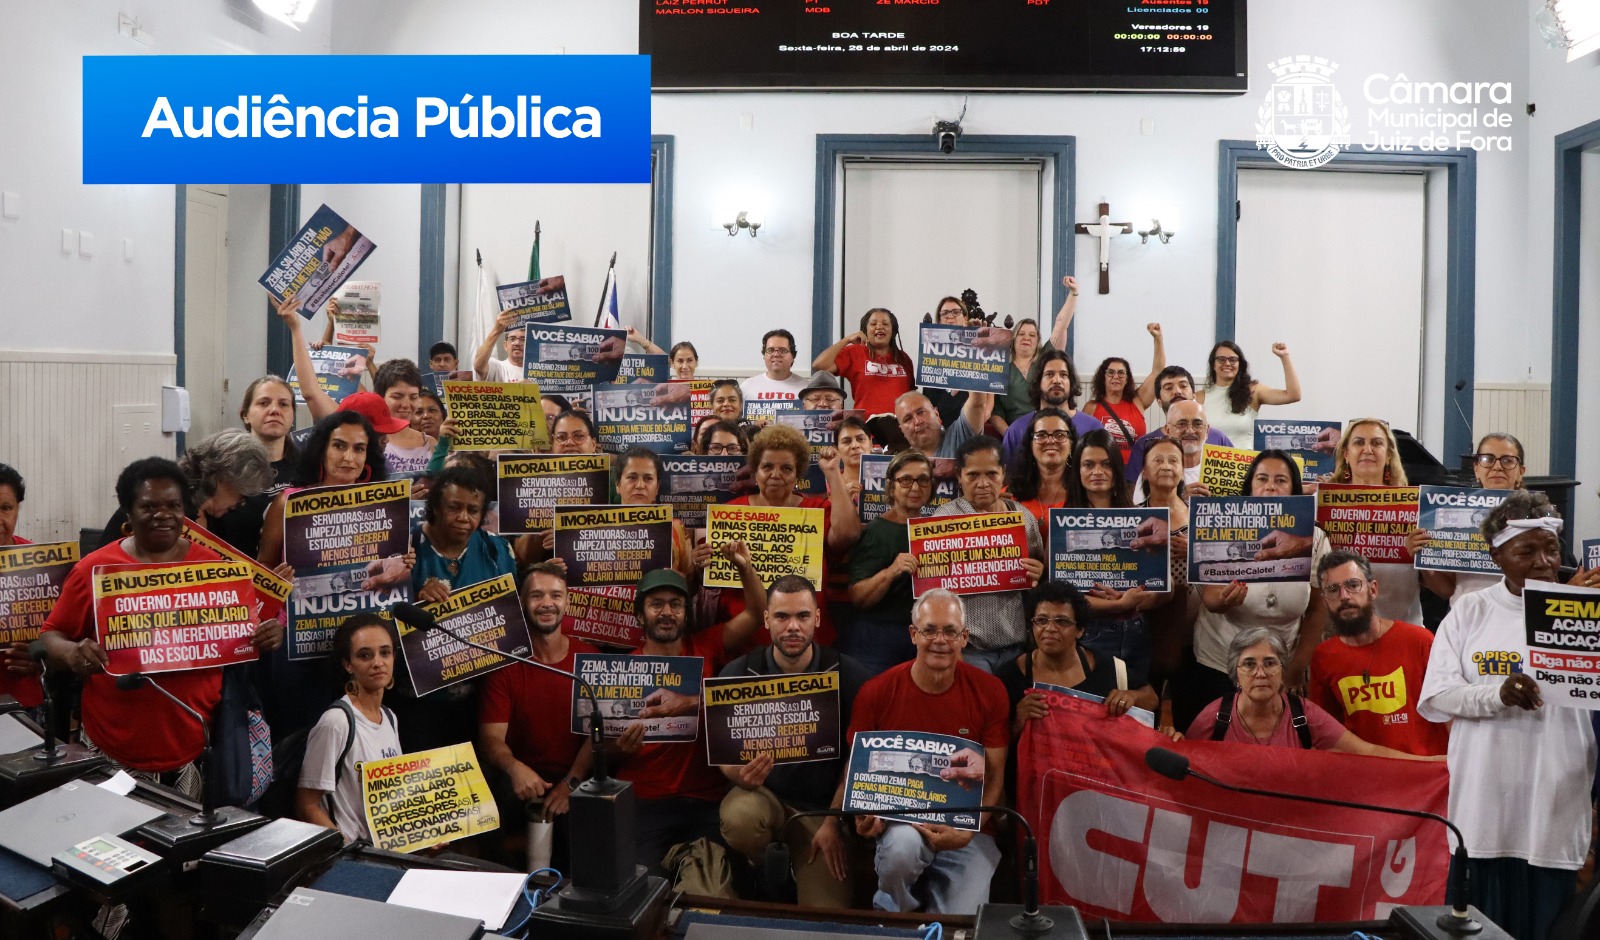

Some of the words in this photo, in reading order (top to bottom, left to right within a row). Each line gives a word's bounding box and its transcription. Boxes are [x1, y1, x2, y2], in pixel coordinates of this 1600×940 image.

[265, 267, 287, 289] ZEMA,
[280, 238, 308, 272] SALÁRIO
[299, 227, 318, 245] TEM
[310, 262, 352, 310] #BastadeCalote!
[501, 291, 565, 311] INJUSTIÇA!
[532, 330, 564, 342] VOCÊ
[566, 332, 605, 344] SABIA?
[922, 342, 1006, 364] INJUSTIÇA!
[447, 384, 473, 394] VOCÊ
[474, 386, 503, 394] SABIA?
[758, 392, 795, 400] LUTO
[448, 394, 478, 402] MINAS
[480, 394, 512, 402] GERAIS
[512, 396, 536, 404] PAGA
[596, 407, 688, 425] INJUSTIÇA!
[1258, 422, 1286, 434] VOCÊ
[1287, 426, 1322, 435] SABIA?
[1206, 449, 1232, 460] VOCÊ
[504, 462, 556, 475] IMORAL!
[558, 458, 604, 472] ILEGAL!
[662, 459, 698, 473] VOCÊ
[699, 462, 741, 473] SABIA?
[292, 494, 353, 514] IMORAL!
[355, 484, 405, 504] ILEGAL!
[1323, 492, 1329, 503] É
[1332, 494, 1382, 503] INJUSTO!
[1384, 490, 1390, 503] É
[1426, 492, 1466, 506] VOCÊ
[712, 509, 742, 521] VOCÊ
[744, 513, 780, 523] SABIA?
[1196, 503, 1224, 517] ZEMA,
[1224, 500, 1262, 516] SALÁRIO
[1263, 504, 1282, 516] TEM
[560, 514, 616, 527] IMORAL!
[618, 509, 667, 522] ILEGAL!
[914, 526, 922, 537] É
[923, 521, 972, 535] INJUSTO!
[974, 518, 981, 529] É
[982, 515, 1022, 528] ILEGAL!
[1056, 513, 1094, 528] VOCÊ
[1096, 516, 1142, 528] SABIA?
[1196, 516, 1213, 528] QUE
[1214, 516, 1231, 528] SER
[1232, 516, 1269, 530] INTEIRO,
[1270, 516, 1276, 528] E
[1277, 514, 1296, 528] NÃO
[923, 538, 964, 552] GOVERNO
[965, 536, 990, 548] ZEMA
[990, 534, 1014, 546] PAGA
[1196, 529, 1219, 540] PELA
[1220, 529, 1258, 541] METADE!
[919, 552, 950, 565] MENOS
[950, 550, 967, 563] QUE
[968, 549, 983, 560] UM
[984, 545, 1021, 559] SALÁRIO
[917, 563, 950, 579] MÍNIMO
[951, 562, 962, 575] ÀS
[963, 558, 1025, 574] MERENDEIRAS
[1204, 566, 1276, 577] #BastadeCalote!
[102, 578, 112, 593] É
[115, 573, 182, 591] INJUSTO!
[185, 568, 194, 582] É
[196, 566, 249, 581] ILEGAL!
[941, 577, 958, 590] DAS
[960, 574, 1001, 589] ESCOLAS.
[115, 594, 172, 614] GOVERNO
[174, 592, 207, 608] ZEMA
[209, 590, 239, 606] PAGA
[294, 586, 408, 616] INJUSTIÇA!
[108, 614, 150, 632] MENOS
[153, 612, 176, 628] QUE
[178, 610, 198, 626] UM
[200, 604, 249, 624] SALÁRIO
[105, 630, 151, 651] MÍNIMO
[154, 628, 170, 646] ÀS
[140, 647, 164, 665] DAS
[167, 643, 221, 663] ESCOLAS.
[1472, 652, 1484, 663] O
[1485, 651, 1521, 663] PISO
[1532, 652, 1564, 668] Diga
[1566, 657, 1593, 670] não
[581, 660, 609, 674] ZEMA,
[610, 659, 649, 673] SALÁRIO
[650, 662, 670, 674] TEM
[1478, 659, 1487, 676] É
[1488, 662, 1511, 676] LEI
[600, 674, 617, 687] SER
[618, 674, 655, 688] INTEIRO,
[655, 674, 662, 686] E
[663, 672, 682, 687] NÃO
[1536, 670, 1566, 685] Diga
[1568, 675, 1593, 686] não
[605, 686, 643, 699] METADE!
[712, 683, 775, 703] IMORAL!
[777, 677, 832, 695] ILEGAL!
[1348, 681, 1396, 705] PSTU
[734, 702, 800, 716] SERVIDORAS(AS)
[800, 700, 813, 711] DA
[727, 716, 764, 728] LIMPEZA
[765, 713, 782, 726] DAS
[783, 711, 820, 725] ESCOLAS
[730, 726, 776, 739] ESTADUAIS
[777, 723, 817, 737] RECEBEM
[861, 734, 904, 750] VOCÊ
[905, 738, 957, 756] SABIA?
[367, 762, 395, 781] VOCÊ
[396, 758, 431, 775] SABIA?
[933, 757, 949, 768] 100
[368, 776, 402, 793] MINAS
[403, 768, 442, 785] GERAIS
[443, 761, 474, 776] PAGA
[369, 793, 378, 804] O
[379, 787, 405, 802] PIOR
[407, 777, 456, 797] SALÁRIO
[370, 803, 389, 817] DO
[390, 797, 434, 813] BRASIL,
[434, 788, 459, 802] AOS
[1049, 790, 1355, 924] CUT
